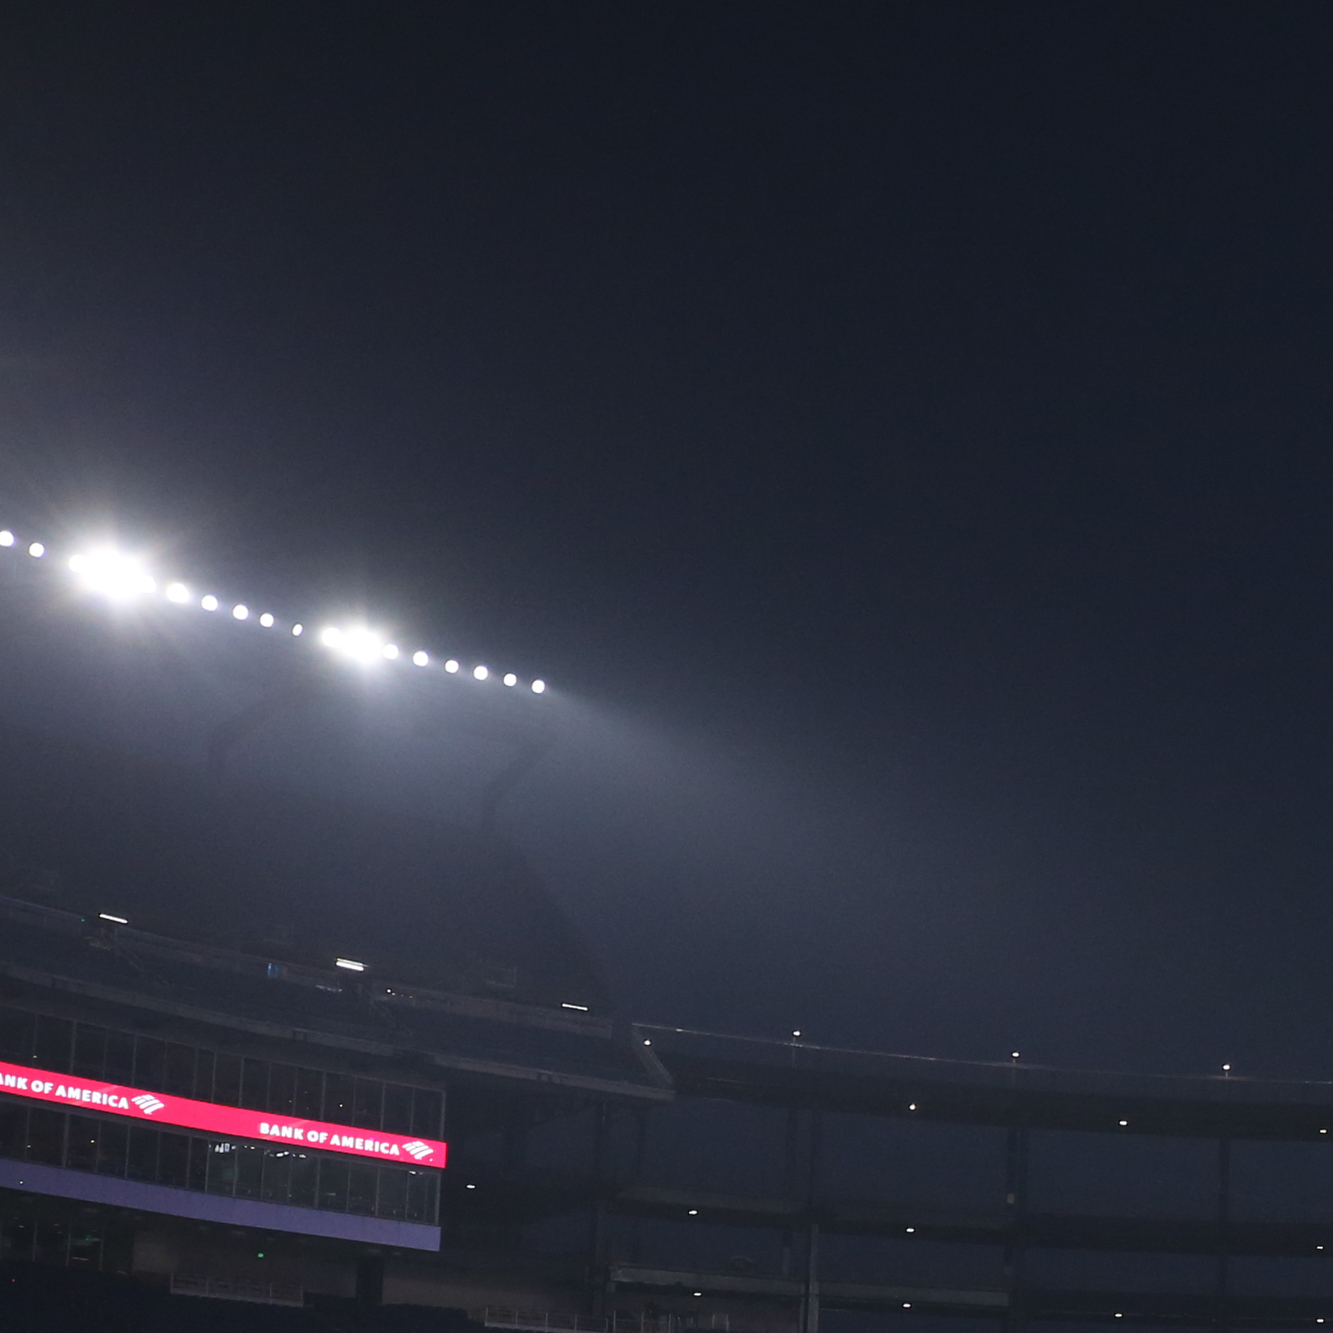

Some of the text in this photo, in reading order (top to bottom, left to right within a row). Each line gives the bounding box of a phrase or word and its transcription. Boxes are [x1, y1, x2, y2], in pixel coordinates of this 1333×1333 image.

[31, 1079, 53, 1095] OF
[55, 1084, 129, 1110] AMERICA
[260, 1122, 400, 1156] BANK OF AMERICA
